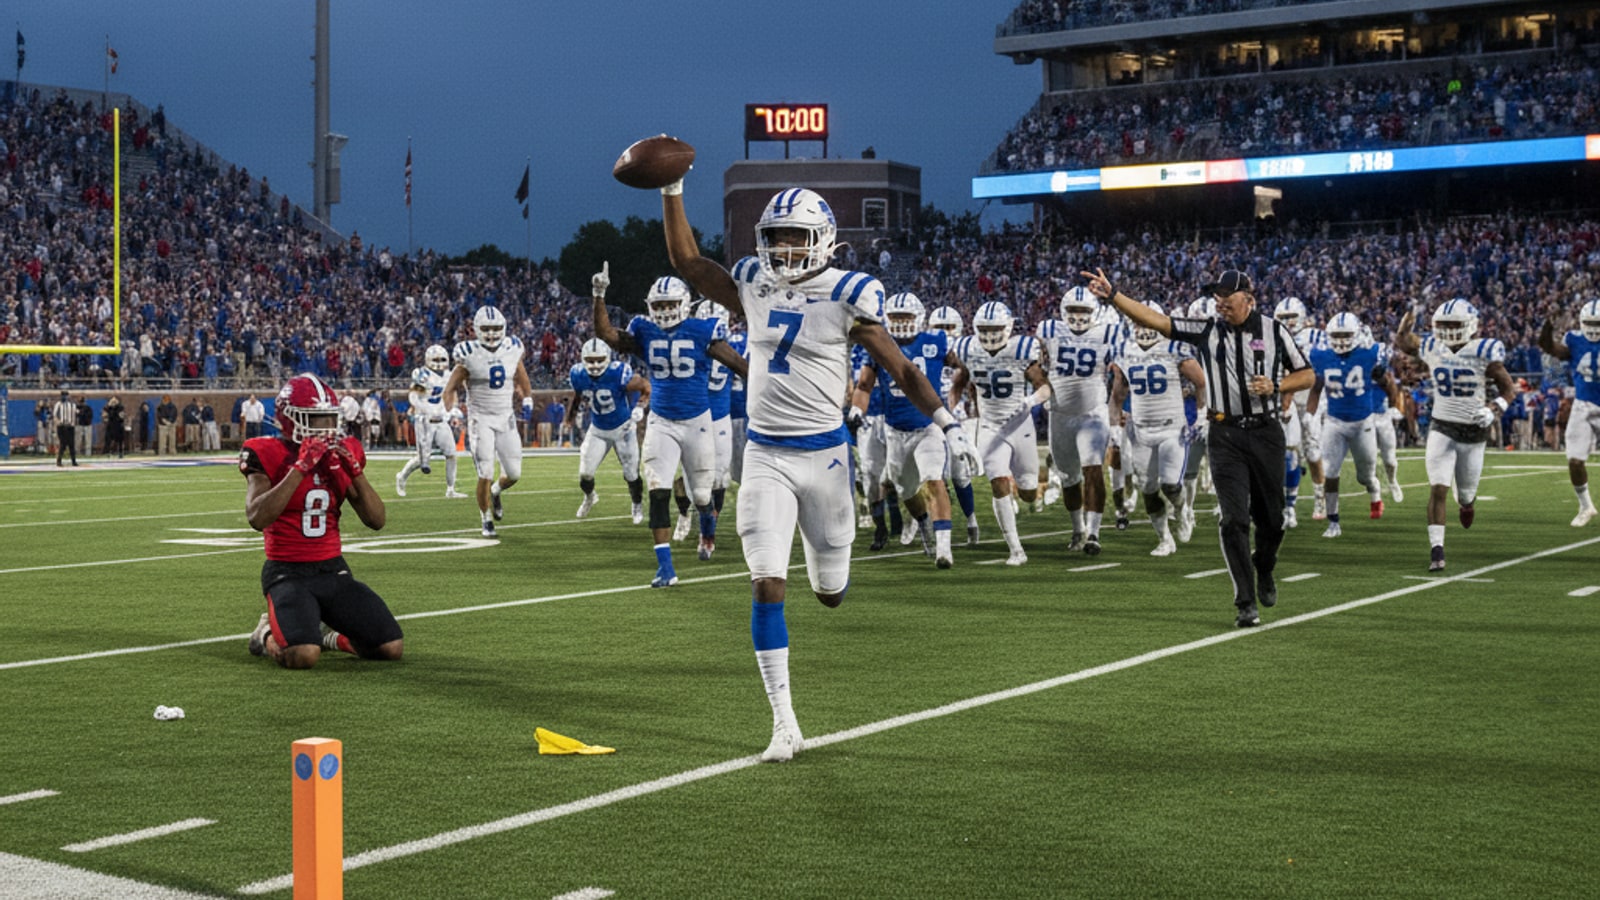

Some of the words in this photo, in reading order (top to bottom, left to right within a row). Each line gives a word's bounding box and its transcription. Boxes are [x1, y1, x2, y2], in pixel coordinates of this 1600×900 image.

[768, 309, 804, 375] 7
[489, 365, 505, 389] 8
[1128, 364, 1168, 395] 56
[1324, 365, 1365, 399] 54
[1576, 351, 1600, 383] 4
[303, 489, 329, 537] 8
